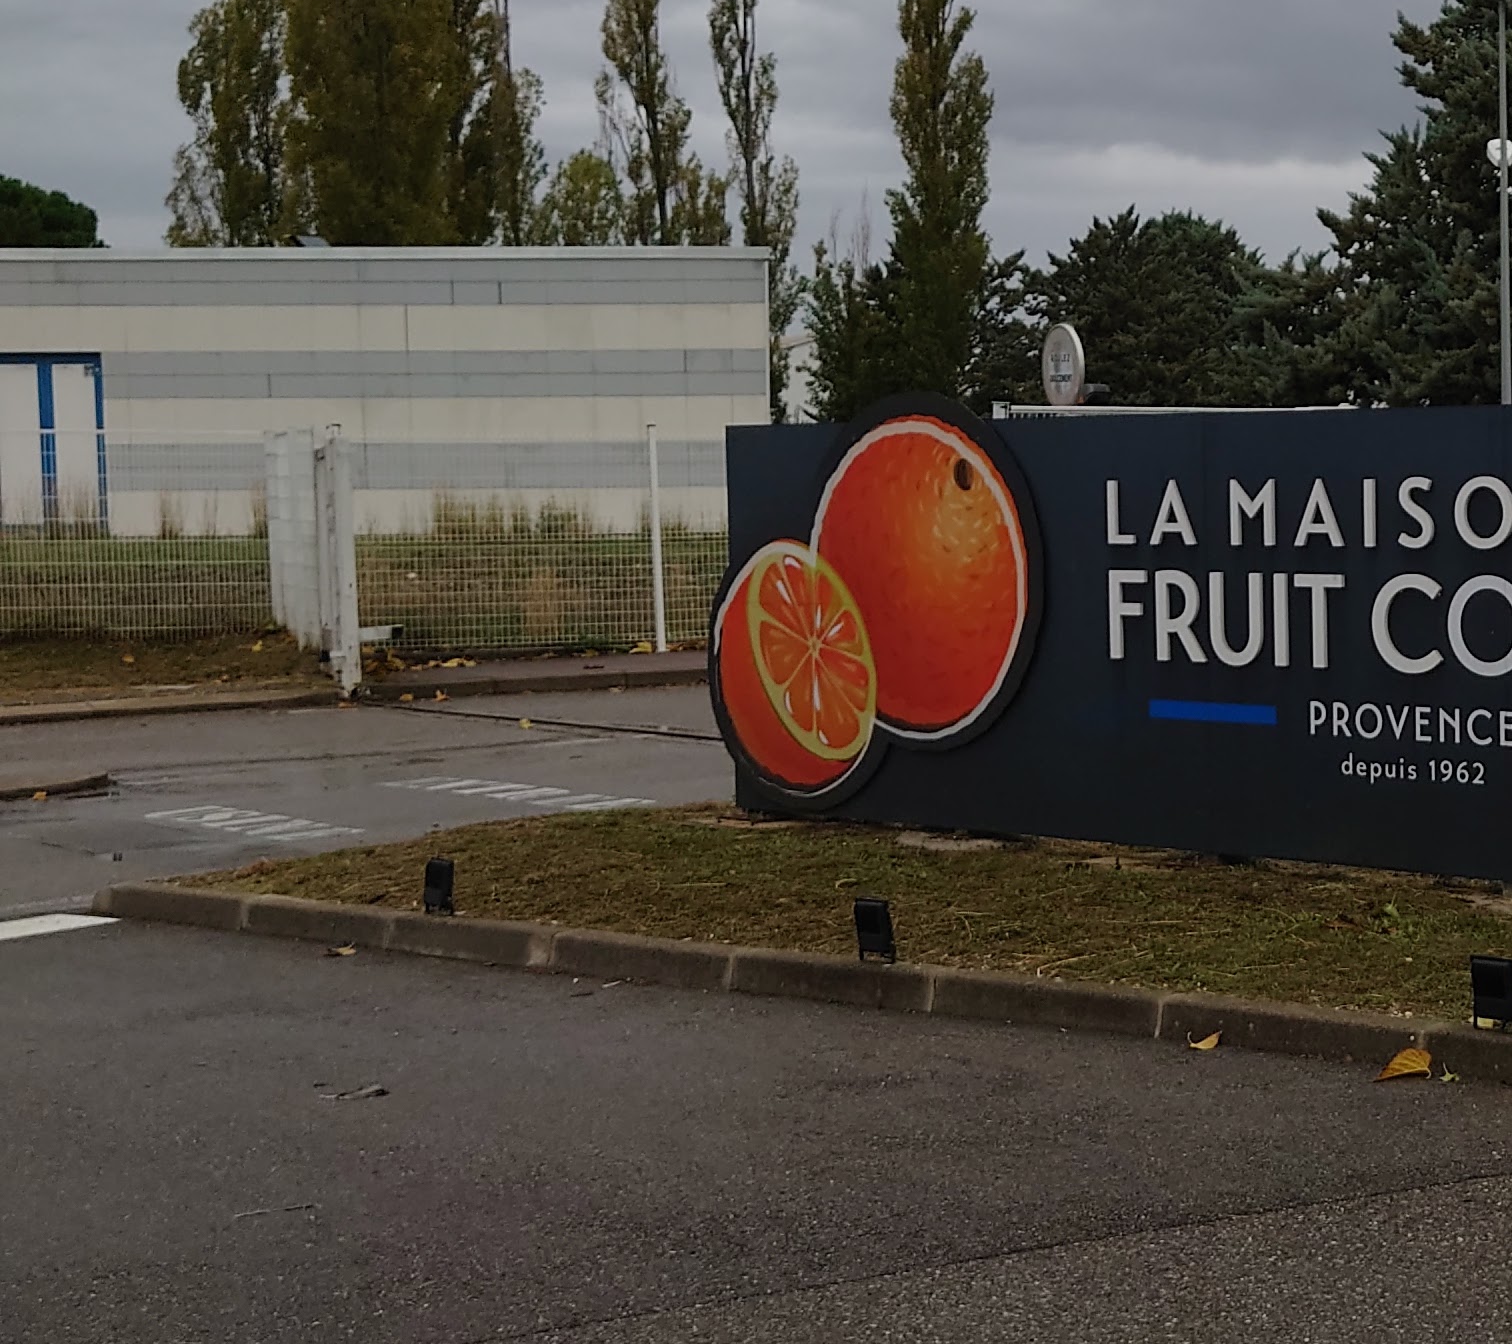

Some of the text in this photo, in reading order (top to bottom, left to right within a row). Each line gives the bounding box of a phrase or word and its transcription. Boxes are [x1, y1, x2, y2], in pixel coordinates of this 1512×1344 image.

[1107, 480, 1197, 545] LA
[1109, 570, 1345, 668] FRUIT
[1342, 753, 1484, 784] depuis 1962
